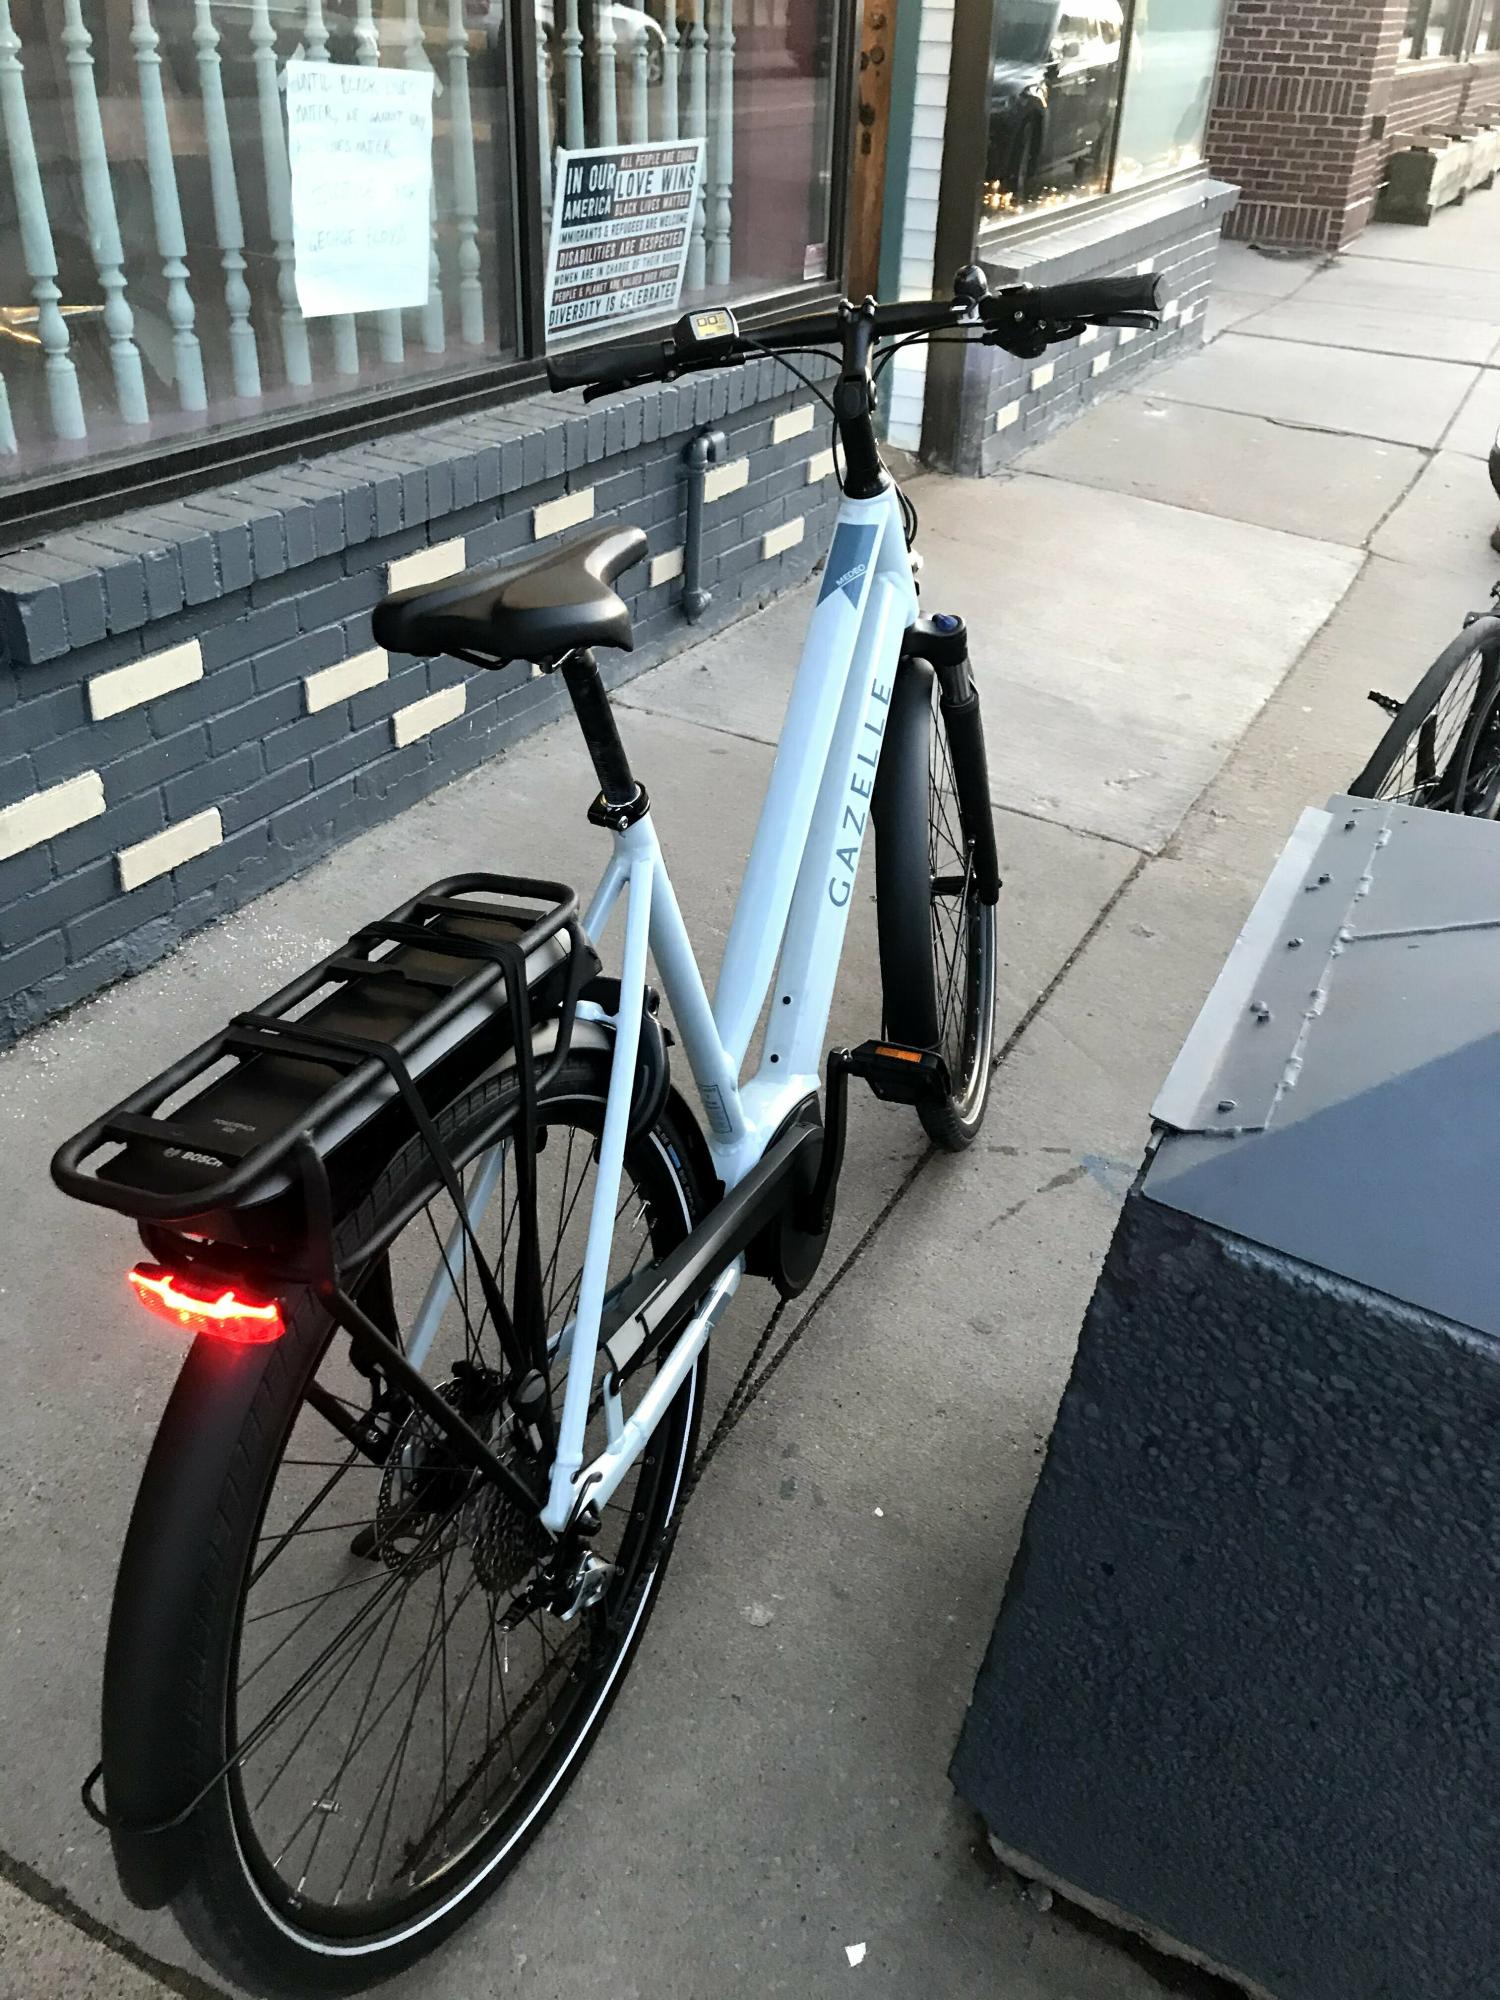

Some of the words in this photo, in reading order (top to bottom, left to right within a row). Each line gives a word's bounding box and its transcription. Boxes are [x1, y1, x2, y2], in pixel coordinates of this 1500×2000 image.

[621, 156, 633, 169] ALL
[636, 153, 660, 166] PEOPLE
[662, 151, 675, 163] ARE
[566, 167, 583, 195] IN
[589, 163, 616, 191] OUR
[617, 171, 654, 196] LOVE
[662, 166, 696, 194] WINS
[564, 195, 611, 221] AMERICA
[614, 203, 638, 217] BLACK
[640, 199, 660, 212] LIVES
[662, 195, 689, 209] MATTER
[560, 227, 602, 244] IMMIGRANTS
[645, 218, 657, 230] ARE
[558, 244, 616, 267] DISABILITIES
[619, 239, 635, 256] ARE
[639, 231, 682, 252] RESPECTED
[554, 271, 579, 286] WOMEN
[581, 268, 594, 281] ARE
[596, 267, 604, 277] IN
[549, 299, 601, 326] DIVERSITY
[606, 296, 615, 312] IS
[620, 282, 677, 309] CELEBRATED
[555, 287, 577, 303] PEOPLE
[584, 280, 607, 297] PLANET
[835, 563, 866, 585] MEDEO
[828, 677, 892, 908] GAZELLE
[181, 1151, 223, 1168] BOSCH
